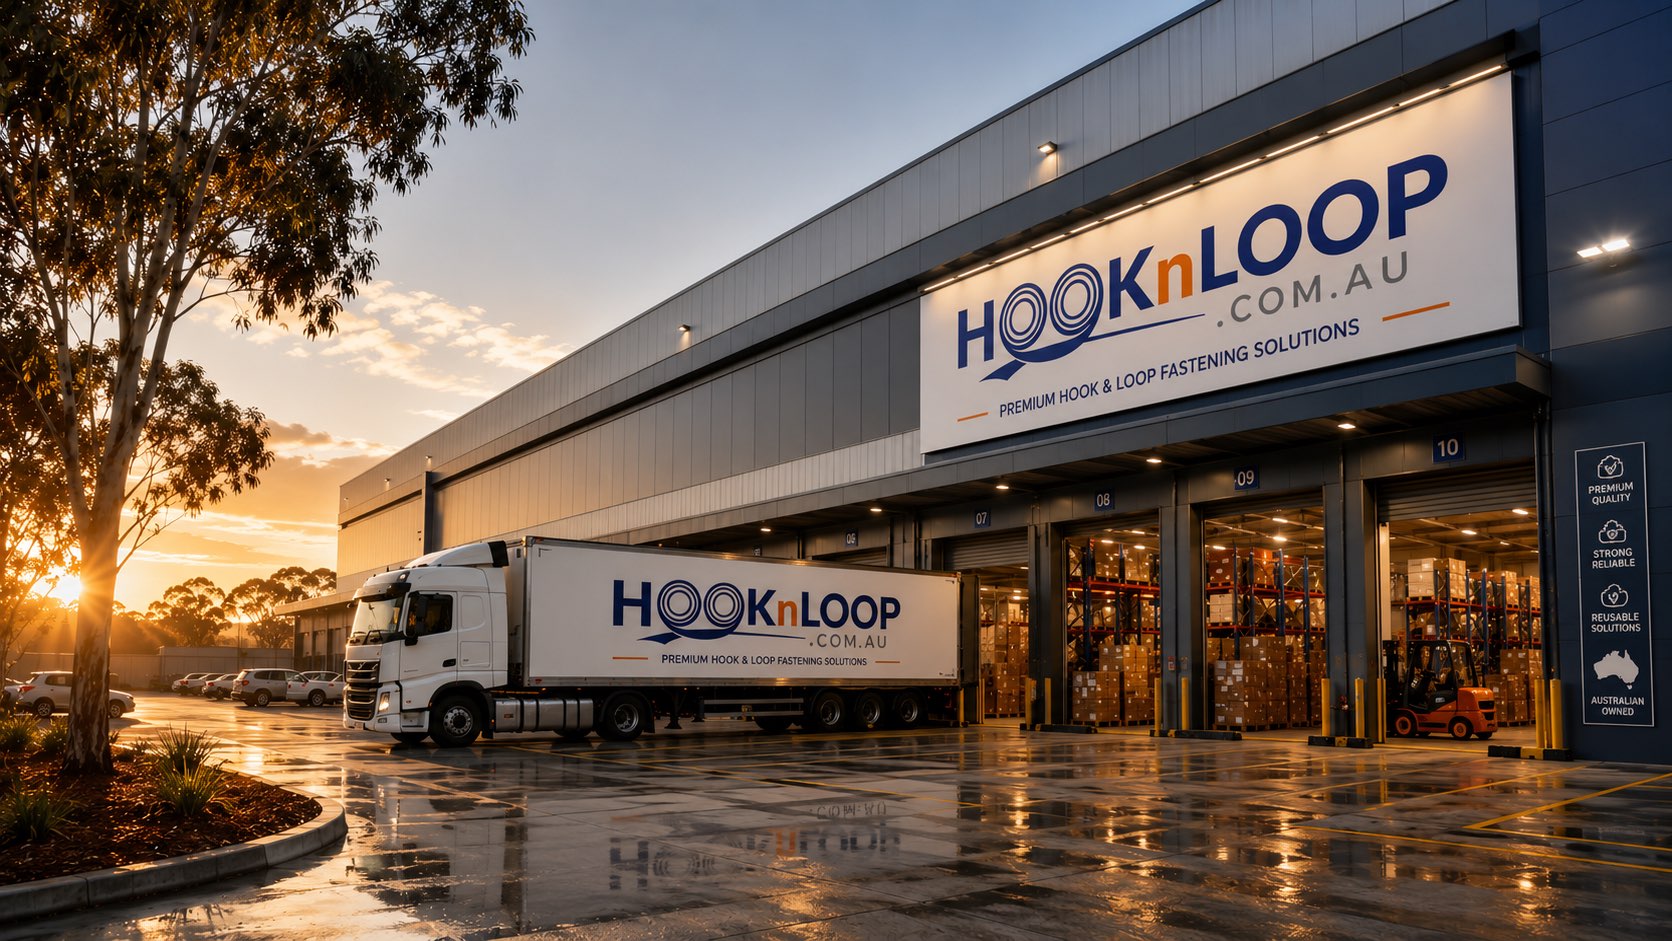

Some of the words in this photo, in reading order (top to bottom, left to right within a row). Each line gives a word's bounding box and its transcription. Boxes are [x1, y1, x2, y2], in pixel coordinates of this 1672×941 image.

[957, 154, 1448, 369] HOOKnLOOP
[1217, 251, 1408, 328] .COM.AU
[1000, 391, 1056, 417] PREMIUM
[1059, 381, 1099, 404] HOOK
[1102, 379, 1112, 394] &
[1116, 368, 1156, 390] LOOP
[1160, 345, 1249, 380] FASTENING
[1254, 318, 1360, 358] SOLUTIONS
[1437, 438, 1459, 457] 10
[1237, 470, 1255, 487] 09
[1588, 482, 1634, 494] PREMIUM
[1096, 493, 1111, 507] 08
[1591, 493, 1631, 506] QUALITY
[975, 512, 988, 525] 07
[1593, 547, 1633, 559] STRONG
[1592, 558, 1636, 569] RELIABLE
[612, 579, 901, 630] HOOKnLOOP
[1591, 612, 1640, 622] REUSABLE
[1591, 623, 1641, 633] SOLUTIONS
[809, 633, 888, 649] .COM.AU
[661, 654, 709, 665] PREMIUM
[711, 655, 740, 665] HOOK
[741, 655, 749, 665] &
[750, 655, 776, 666] LOOP
[777, 656, 823, 667] FASTENING
[824, 657, 868, 667] SOLUTIONS
[1590, 696, 1645, 706] AUSTRALIAN
[1601, 707, 1635, 716] OWNED
